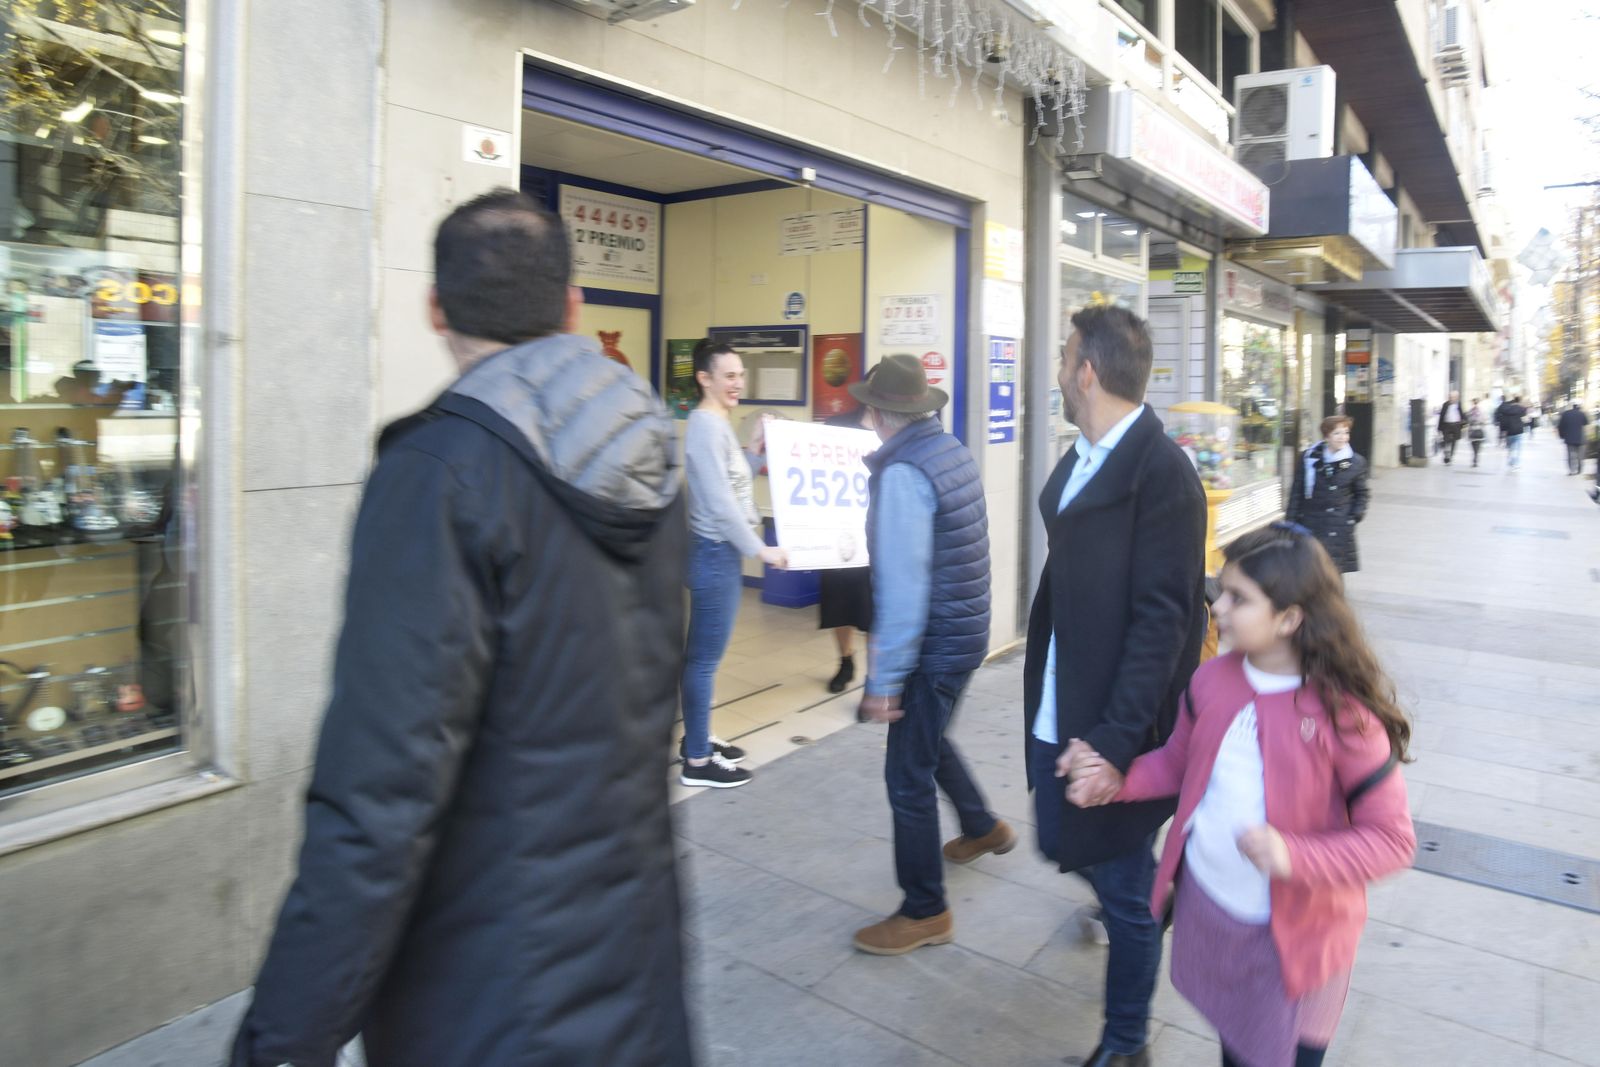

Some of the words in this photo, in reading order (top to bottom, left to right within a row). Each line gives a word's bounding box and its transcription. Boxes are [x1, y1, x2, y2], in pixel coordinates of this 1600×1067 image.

[574, 205, 648, 232] 44469
[589, 230, 646, 253] PREMIO
[789, 441, 803, 462] 4
[809, 443, 873, 466] PREM
[787, 467, 869, 508] 2529
